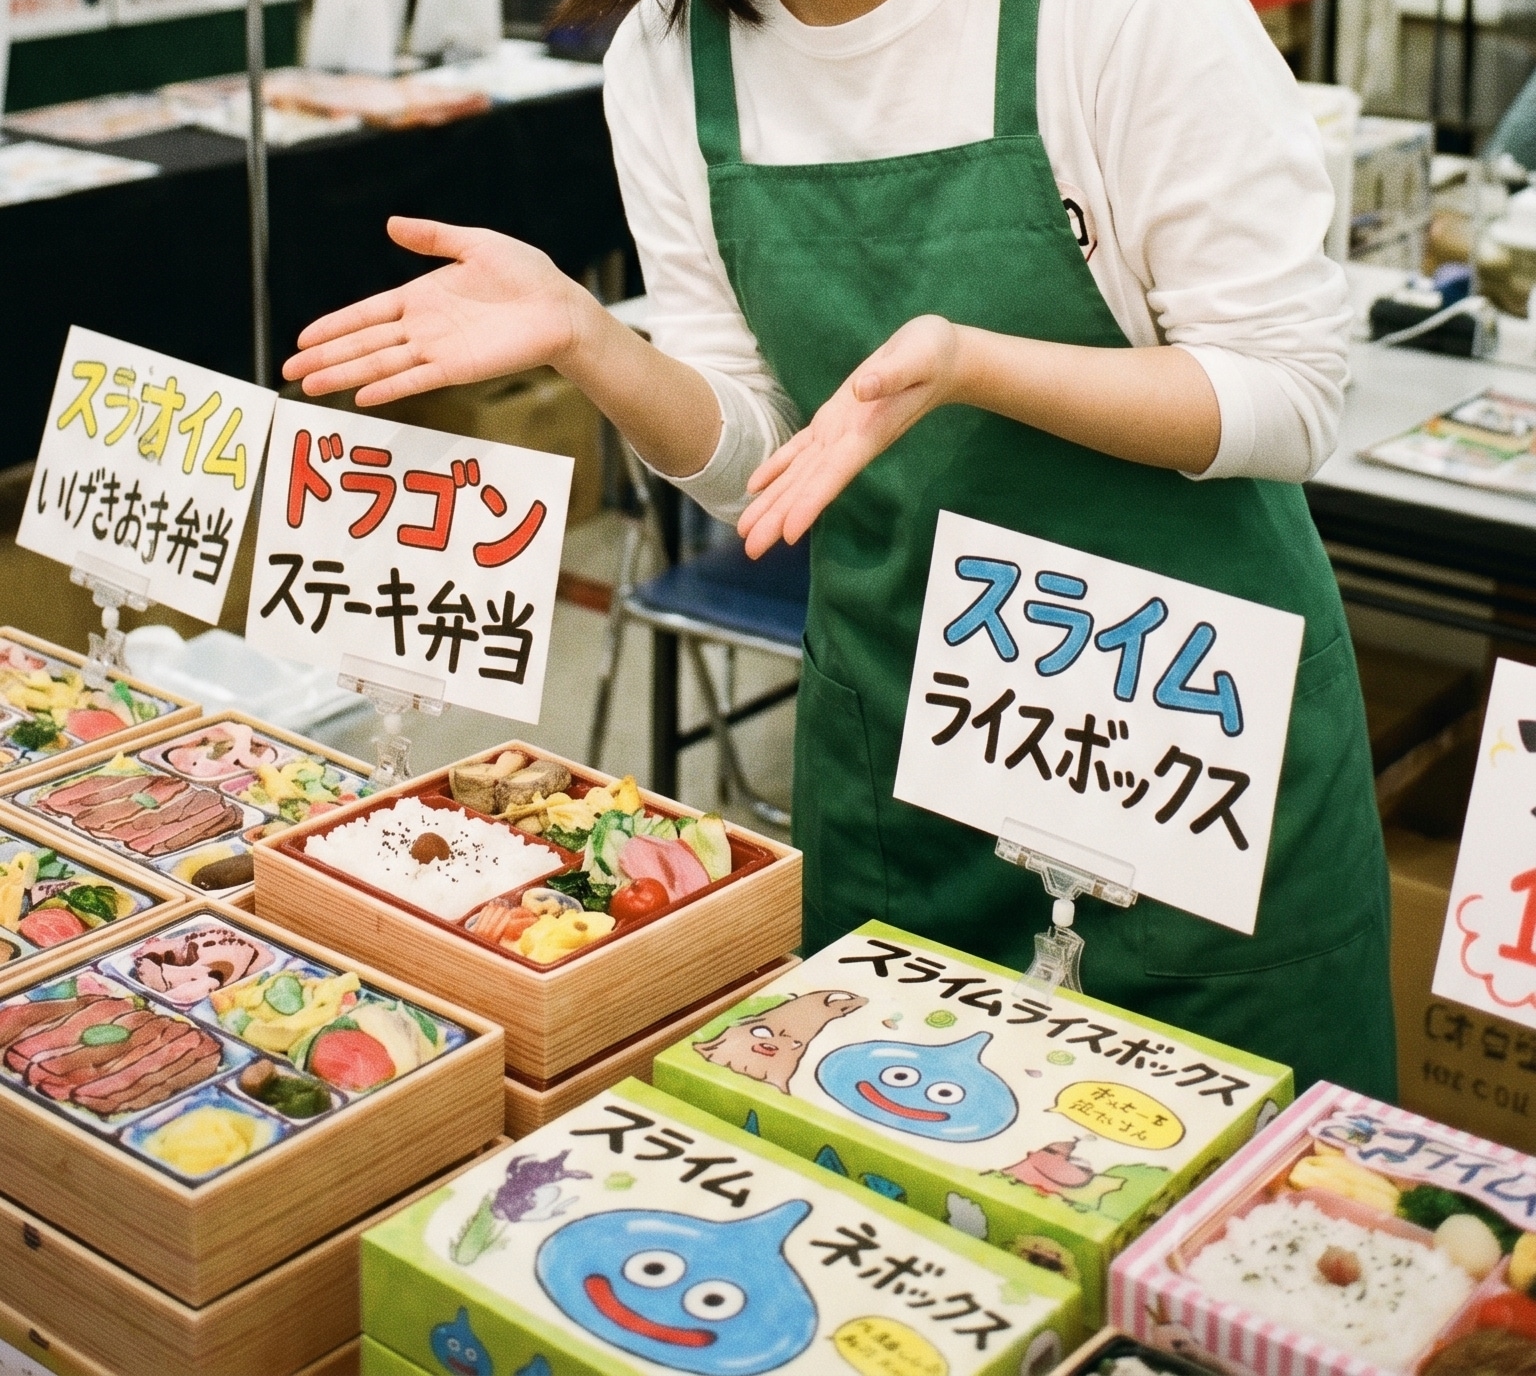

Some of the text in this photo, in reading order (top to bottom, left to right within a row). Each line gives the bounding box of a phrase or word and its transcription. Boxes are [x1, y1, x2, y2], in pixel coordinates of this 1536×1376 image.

[286, 428, 548, 569] ドラゴン
[260, 553, 535, 686] ステーキ弁当
[943, 555, 1245, 738] スライム
[925, 671, 1252, 852] ライスボックス
[837, 939, 1251, 1107] スライムライスボックス
[568, 1104, 753, 1208] スライム
[810, 1222, 1013, 1353] ネボックス
